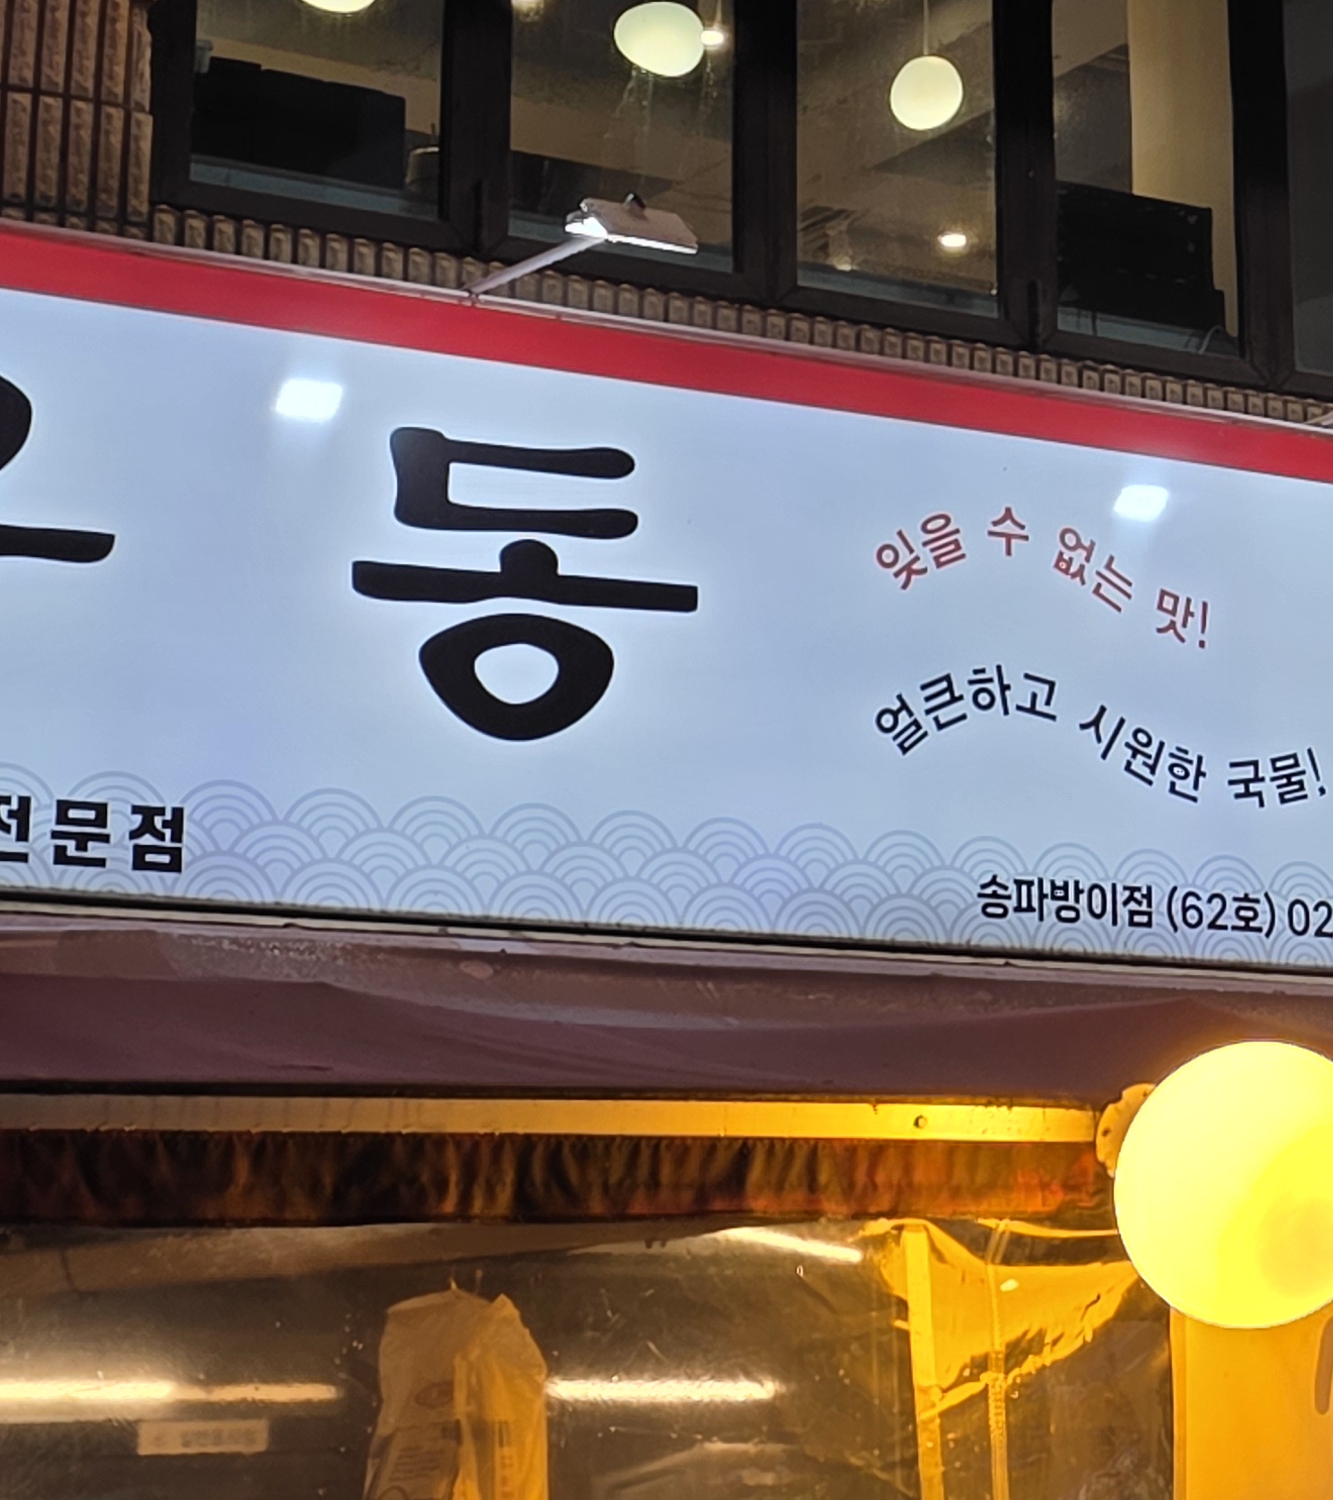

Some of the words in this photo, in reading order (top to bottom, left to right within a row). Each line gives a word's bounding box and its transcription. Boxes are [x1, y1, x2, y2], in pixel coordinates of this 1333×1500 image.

[874, 510, 966, 591] 잊을
[986, 505, 1030, 558] 수
[1052, 525, 1133, 613] 없는
[1154, 587, 1211, 649] 맛!
[873, 663, 1059, 756] 얼큰하고
[1079, 703, 1206, 805] 시원한
[1227, 746, 1328, 809] 국물!
[975, 870, 1154, 928] 송파방이점
[1164, 886, 1278, 940] (62호)
